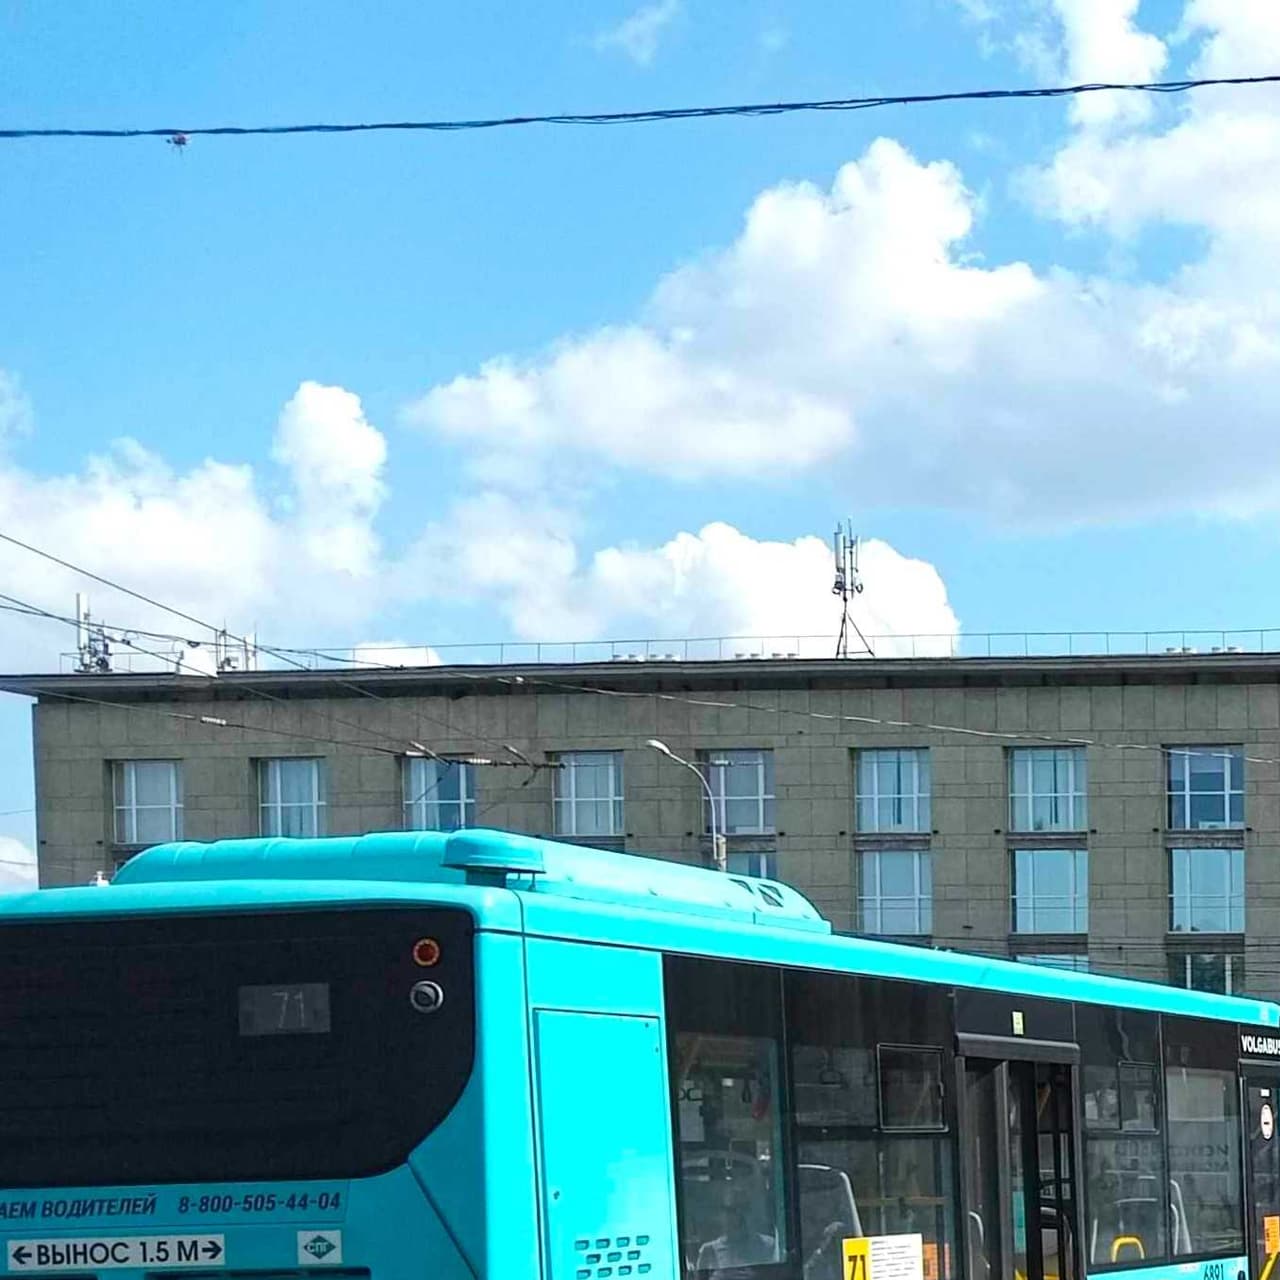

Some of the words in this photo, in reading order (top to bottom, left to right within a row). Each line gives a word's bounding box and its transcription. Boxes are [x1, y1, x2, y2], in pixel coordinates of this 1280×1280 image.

[271, 991, 305, 1029] 71
[41, 1194, 156, 1217] ВОДИТЕЛЕЙ
[178, 1192, 341, 1214] 8-800-505-44-04
[37, 1242, 130, 1265] ВЫНОС
[139, 1241, 170, 1263] 1.5
[177, 1240, 199, 1261] М
